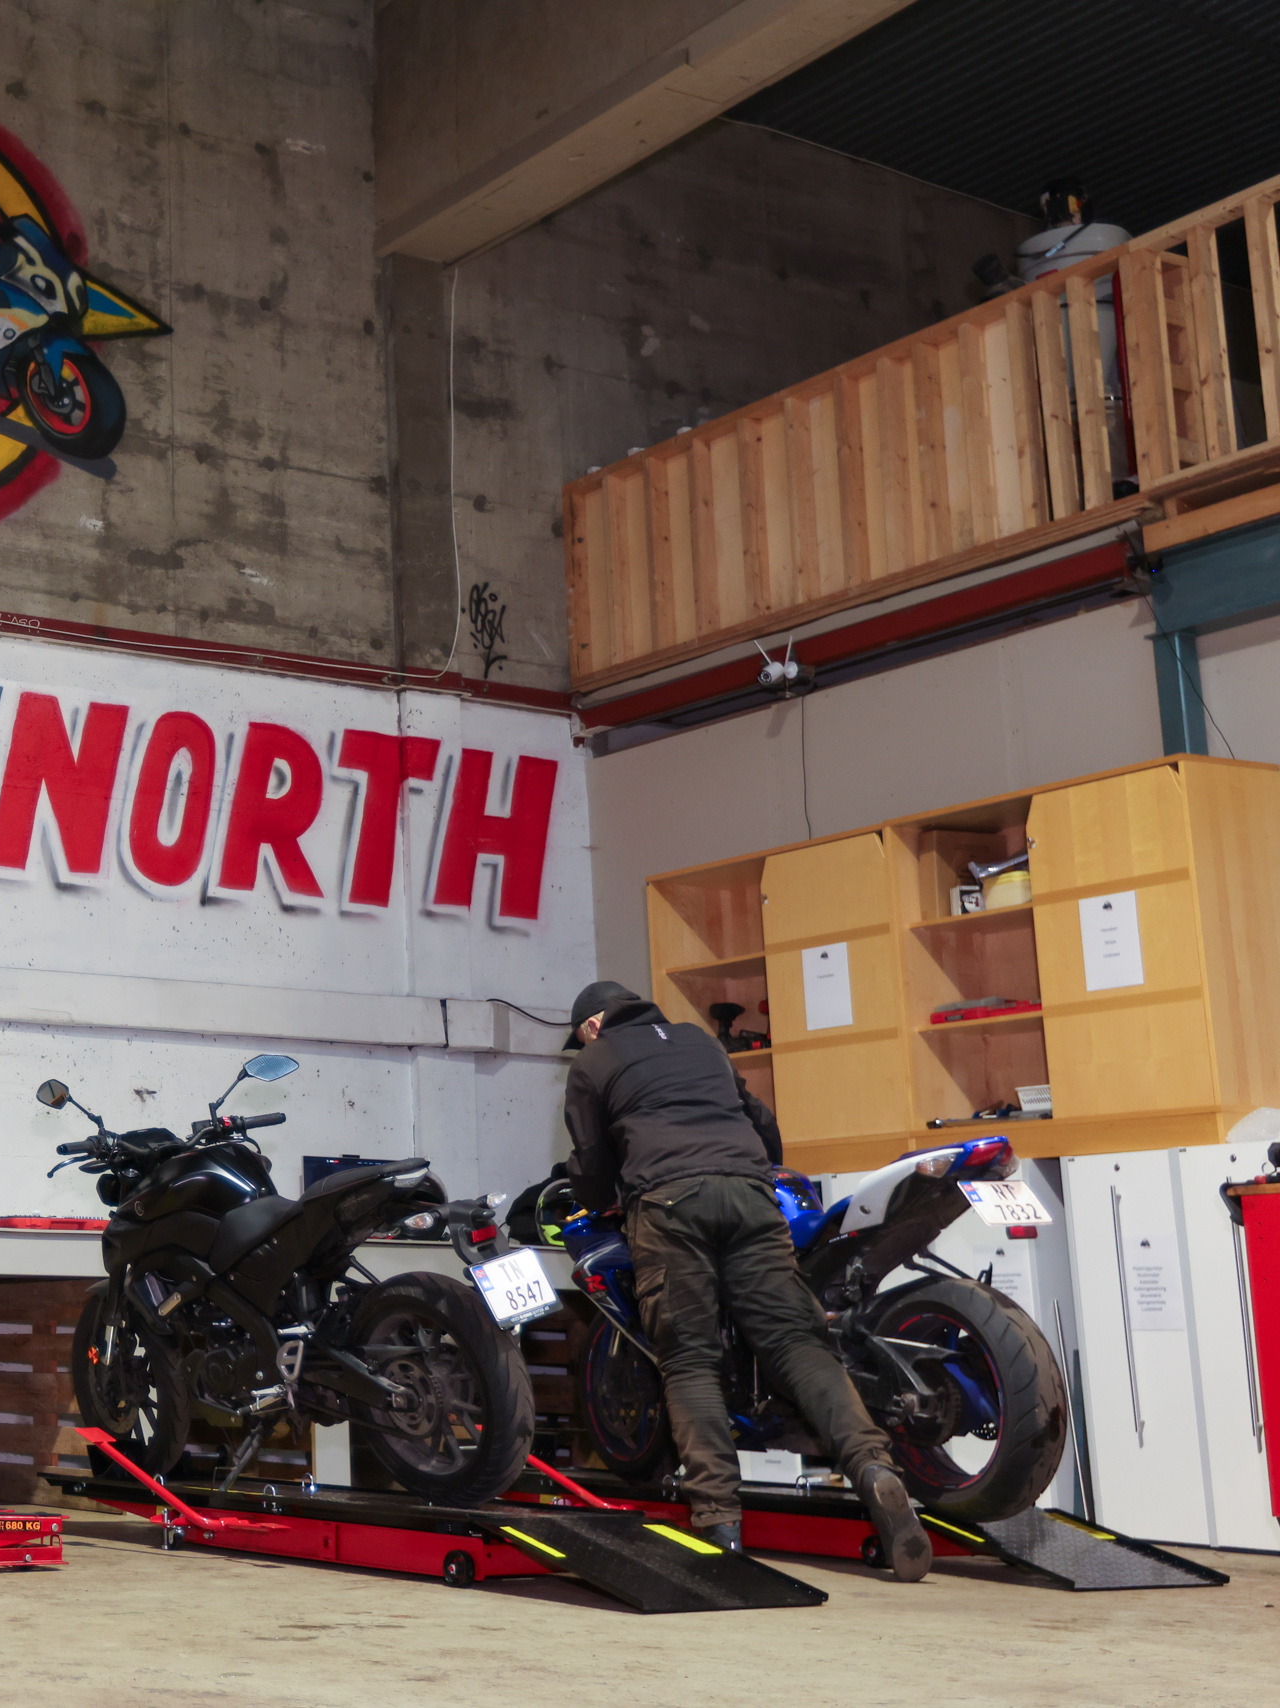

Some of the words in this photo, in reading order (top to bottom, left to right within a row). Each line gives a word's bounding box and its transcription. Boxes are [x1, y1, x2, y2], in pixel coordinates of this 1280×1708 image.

[990, 1183, 1017, 1201] NT
[994, 1203, 1042, 1221] 7832
[497, 1258, 526, 1283] TN
[505, 1279, 544, 1311] 8547
[5, 1521, 24, 1530] 680
[25, 1521, 41, 1531] KG
